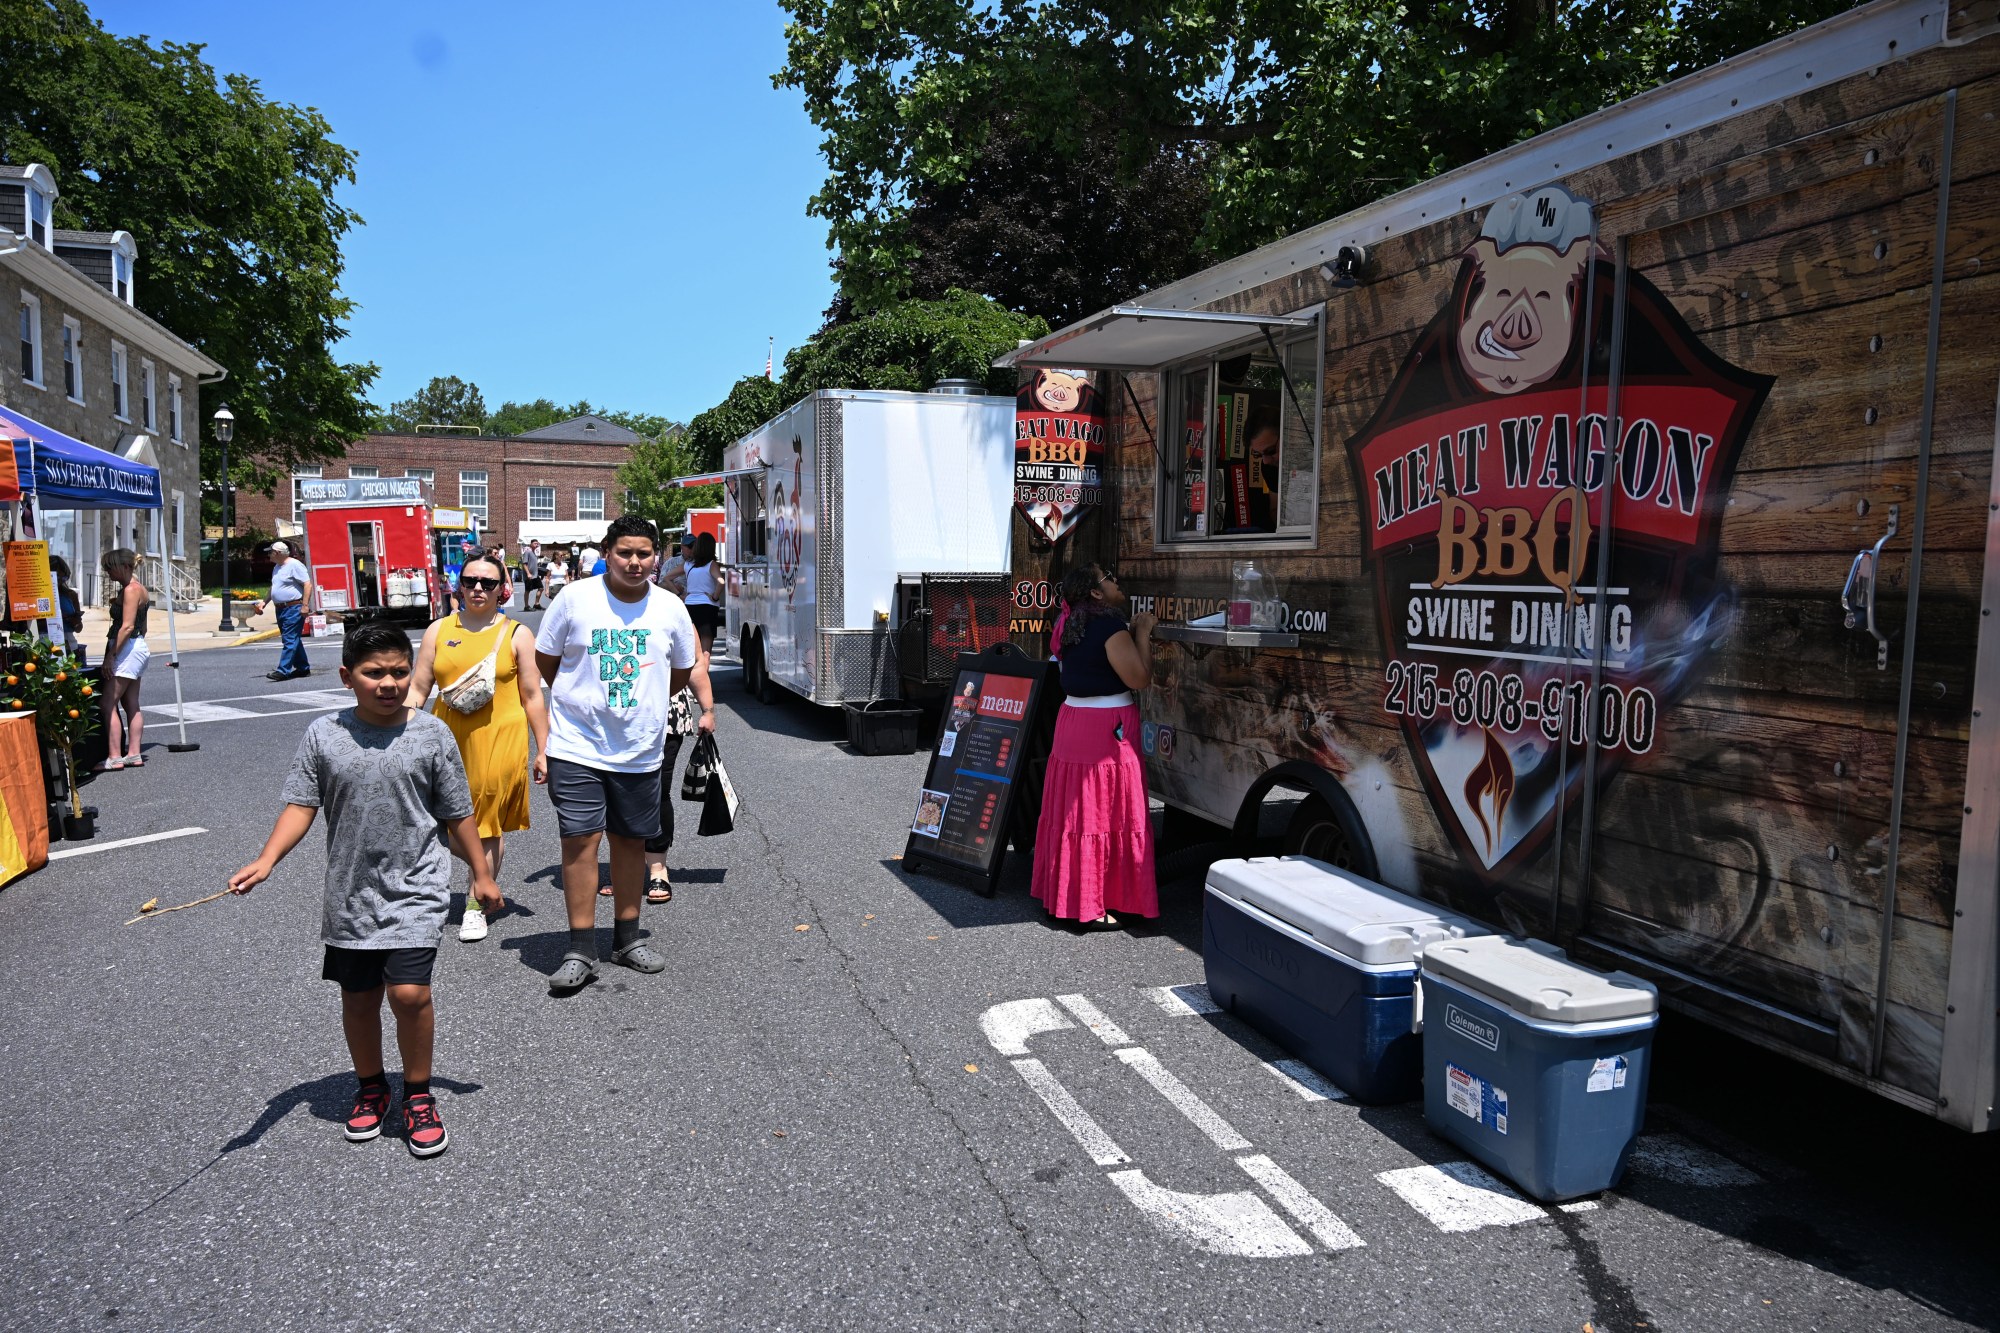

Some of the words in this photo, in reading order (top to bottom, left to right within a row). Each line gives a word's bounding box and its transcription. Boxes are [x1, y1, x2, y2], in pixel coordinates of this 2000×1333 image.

[1016, 418, 1049, 441] EAT
[1054, 418, 1104, 445] WAGO
[1028, 435, 1087, 471] BBQ
[45, 457, 107, 489] SILVERBACK
[108, 468, 154, 496] DISTILLERY
[1016, 466, 1054, 480] SWINE
[1060, 467, 1097, 481] DINING
[1235, 468, 1246, 503] BRISKET
[1375, 423, 1488, 531] MEAT
[1499, 414, 1714, 517] WAGON
[302, 484, 327, 499] CHEESE
[328, 483, 347, 498] FRIES
[361, 481, 388, 497] CHICKEN
[390, 480, 421, 496] NUGGETS
[1014, 485, 1103, 505] 15-808-9100
[1432, 487, 1593, 610] BBQ
[1407, 596, 1495, 641] SWINE
[587, 629, 651, 655] JUST
[600, 655, 640, 681] DO
[608, 681, 638, 708] IT.
[981, 695, 1024, 715] menu
[1384, 659, 1656, 754] 215-808-9100
[1450, 1009, 1485, 1038] Coleman
